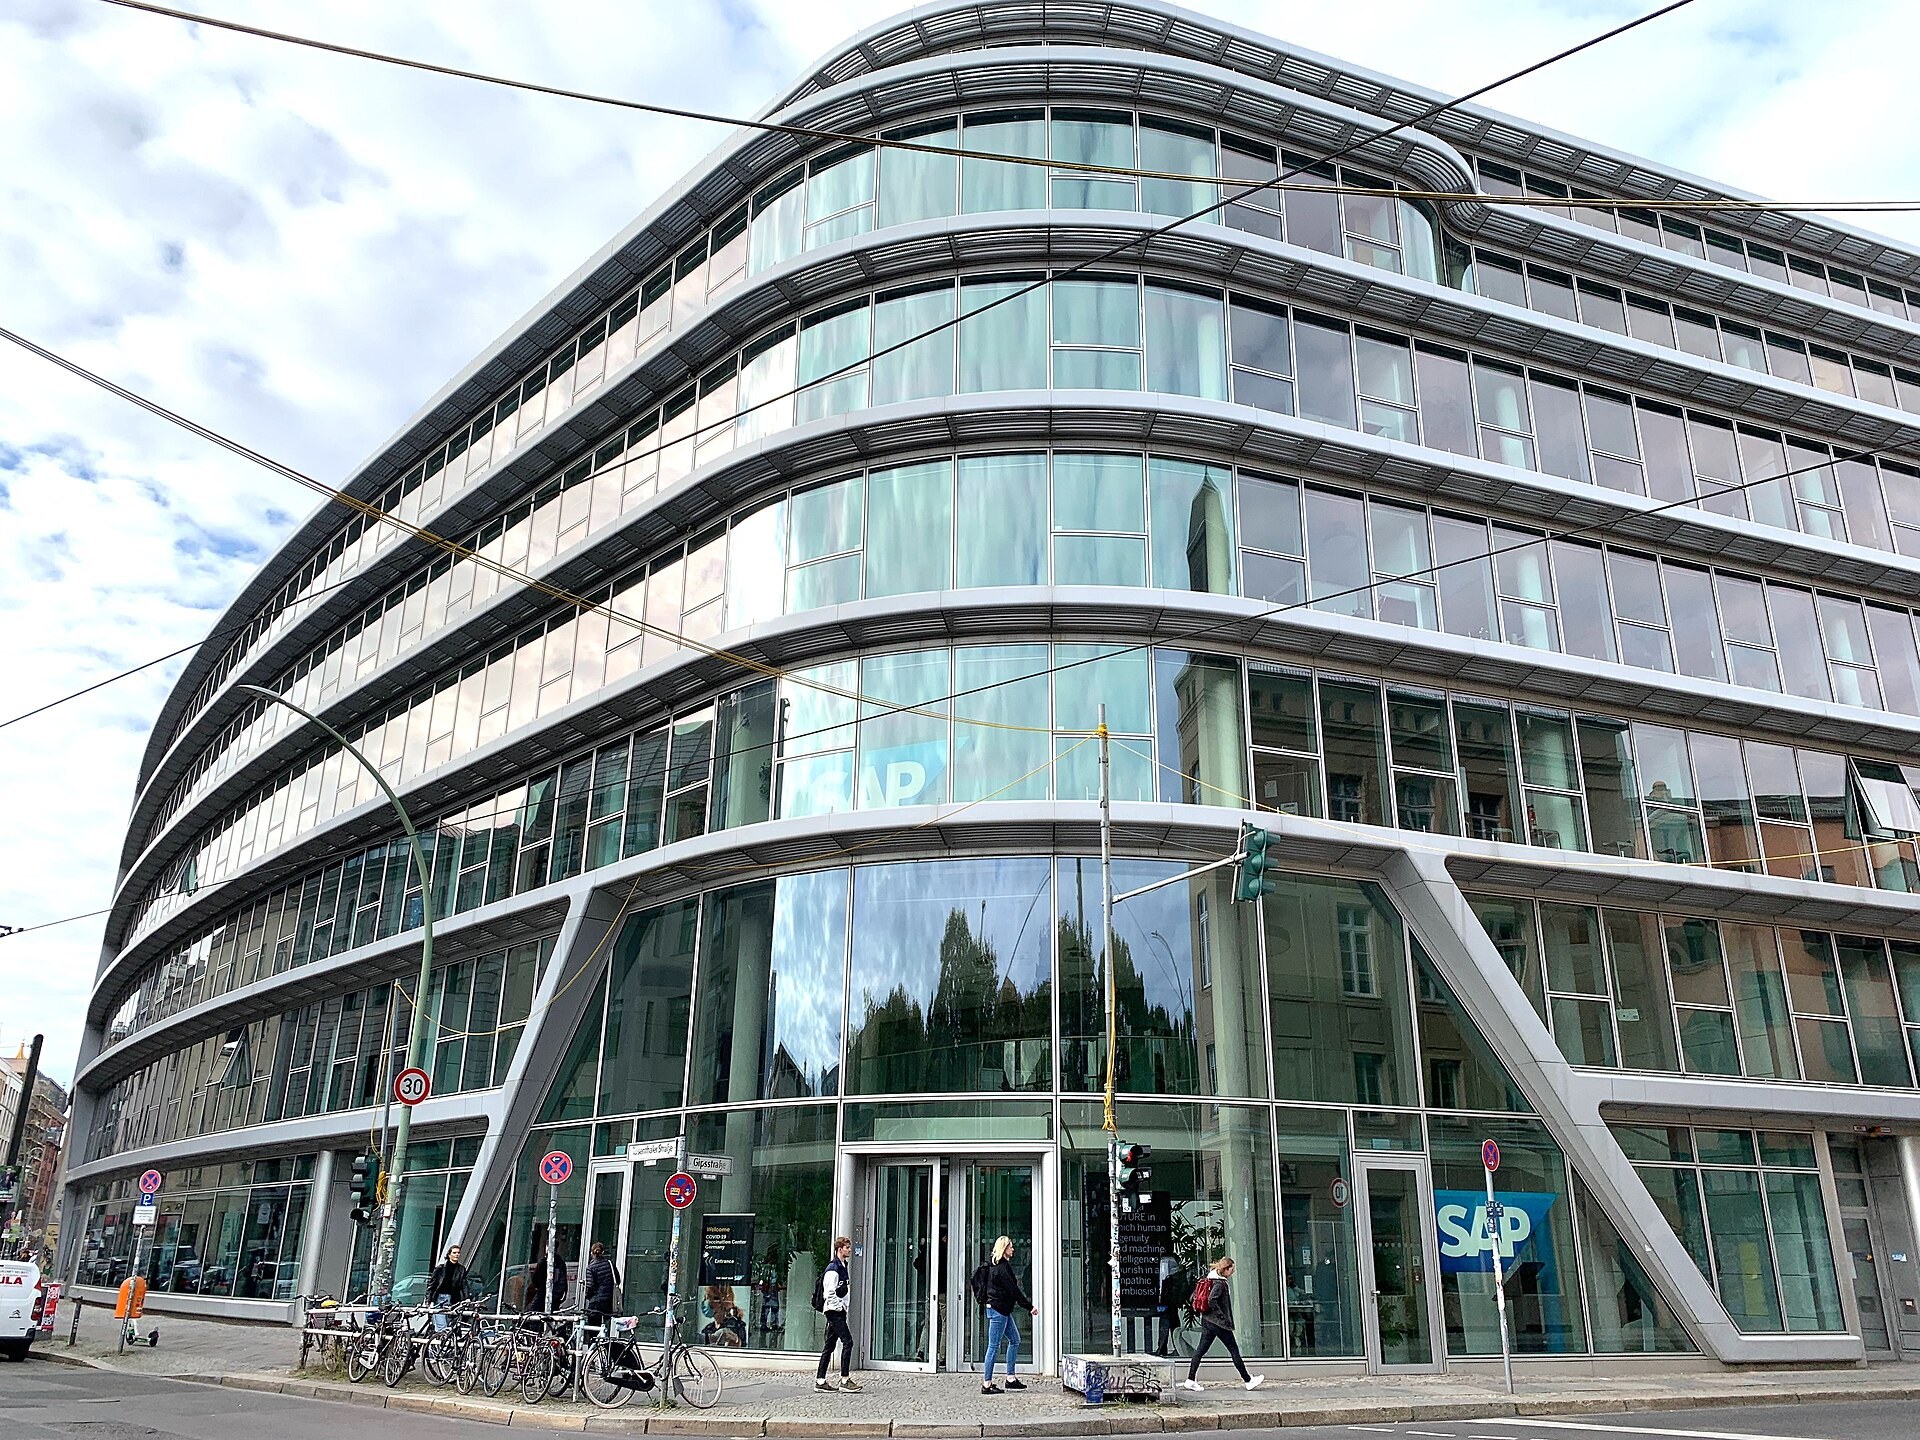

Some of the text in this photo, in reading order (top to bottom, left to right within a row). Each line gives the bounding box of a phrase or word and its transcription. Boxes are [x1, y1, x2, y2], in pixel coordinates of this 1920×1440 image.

[811, 761, 926, 810] SAP
[402, 1078, 423, 1095] 30
[693, 1157, 726, 1170] Gipsstraße
[143, 1194, 151, 1203] P
[1119, 1213, 1146, 1221] TURE
[1137, 1223, 1167, 1232] human
[1437, 1204, 1531, 1258] SAP
[1119, 1234, 1150, 1244] genuity
[1129, 1244, 1165, 1253] machine
[1119, 1254, 1159, 1266] telligence
[1145, 1265, 1153, 1274] in
[1121, 1287, 1157, 1296] mbiosis!
